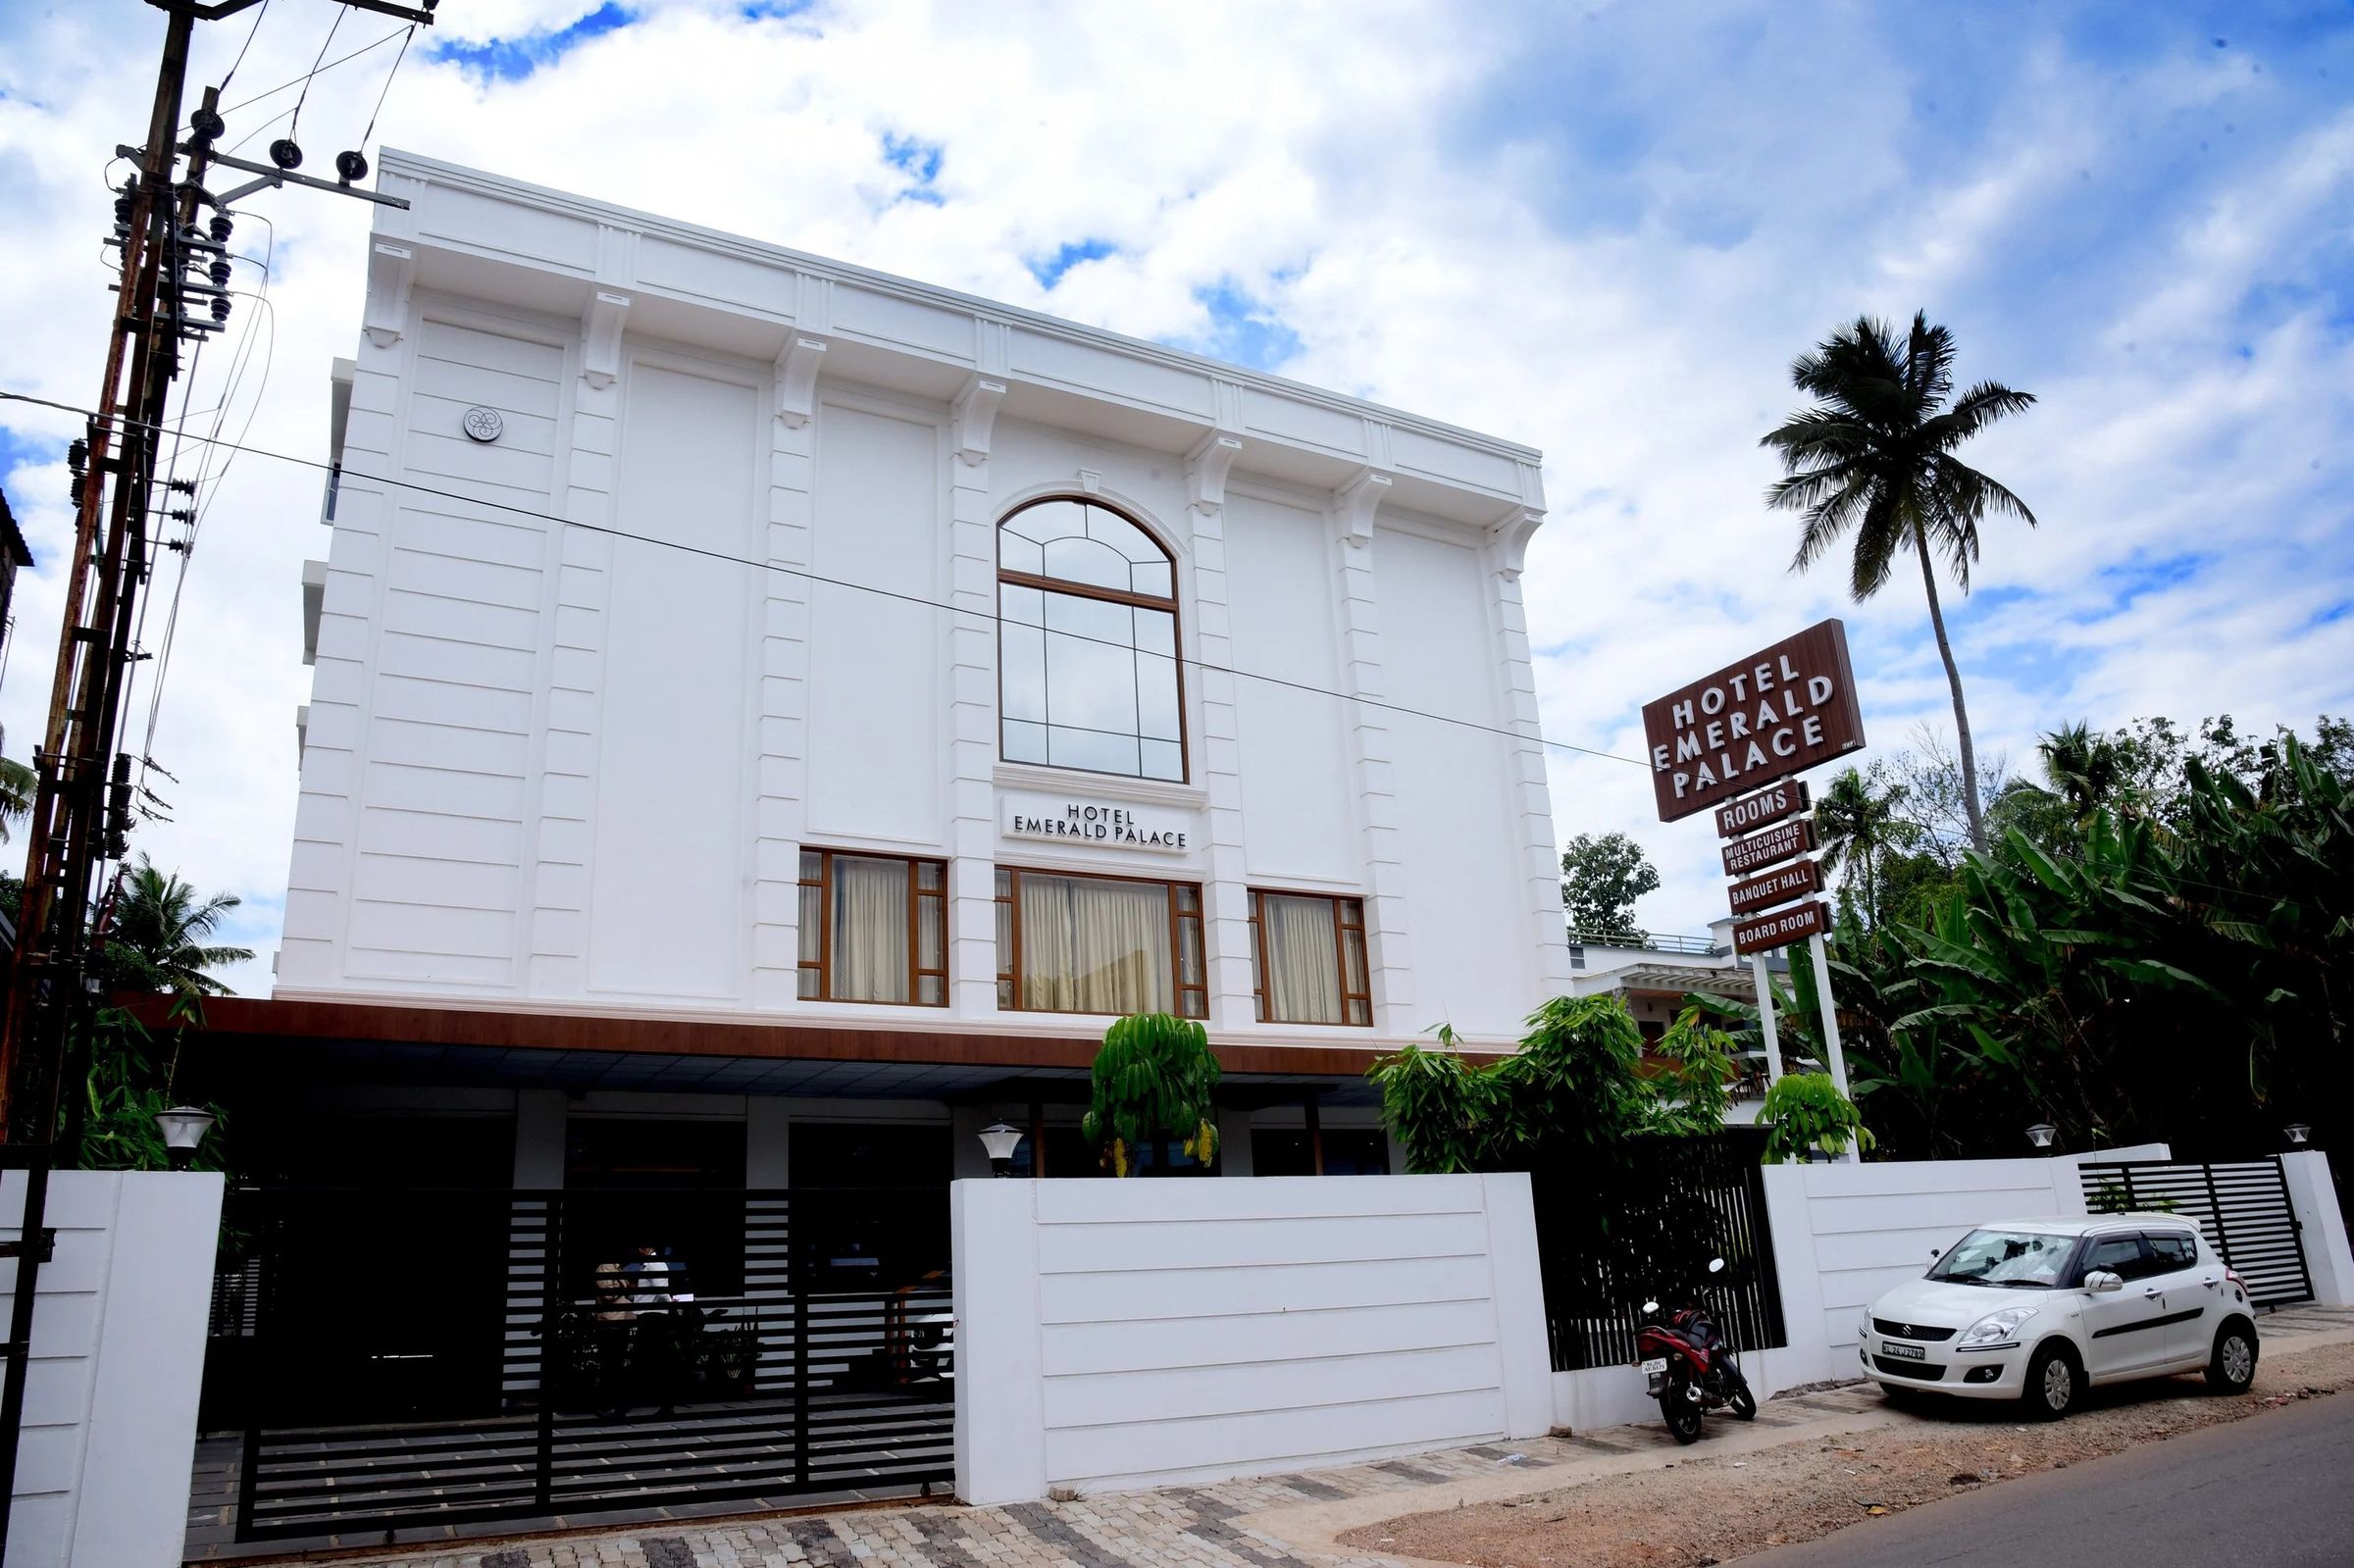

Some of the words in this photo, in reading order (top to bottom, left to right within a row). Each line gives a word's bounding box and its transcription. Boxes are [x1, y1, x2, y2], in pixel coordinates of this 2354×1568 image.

[1672, 654, 1800, 730] HOTEL
[1653, 676, 1833, 772] EMERALD
[1672, 715, 1823, 799] PALACE
[1067, 804, 1135, 825] HOTEL
[1723, 789, 1787, 830] ROOMS
[1014, 815, 1107, 839] EMERALD
[1114, 826, 1186, 847] PALACE
[1724, 824, 1801, 860] MULTICUISINE
[1730, 837, 1798, 871] RESTAURANT
[1732, 878, 1778, 905] BANQUET
[1780, 869, 1809, 889] HALL
[1738, 922, 1777, 944] BOARD
[1779, 910, 1815, 933] ROOM
